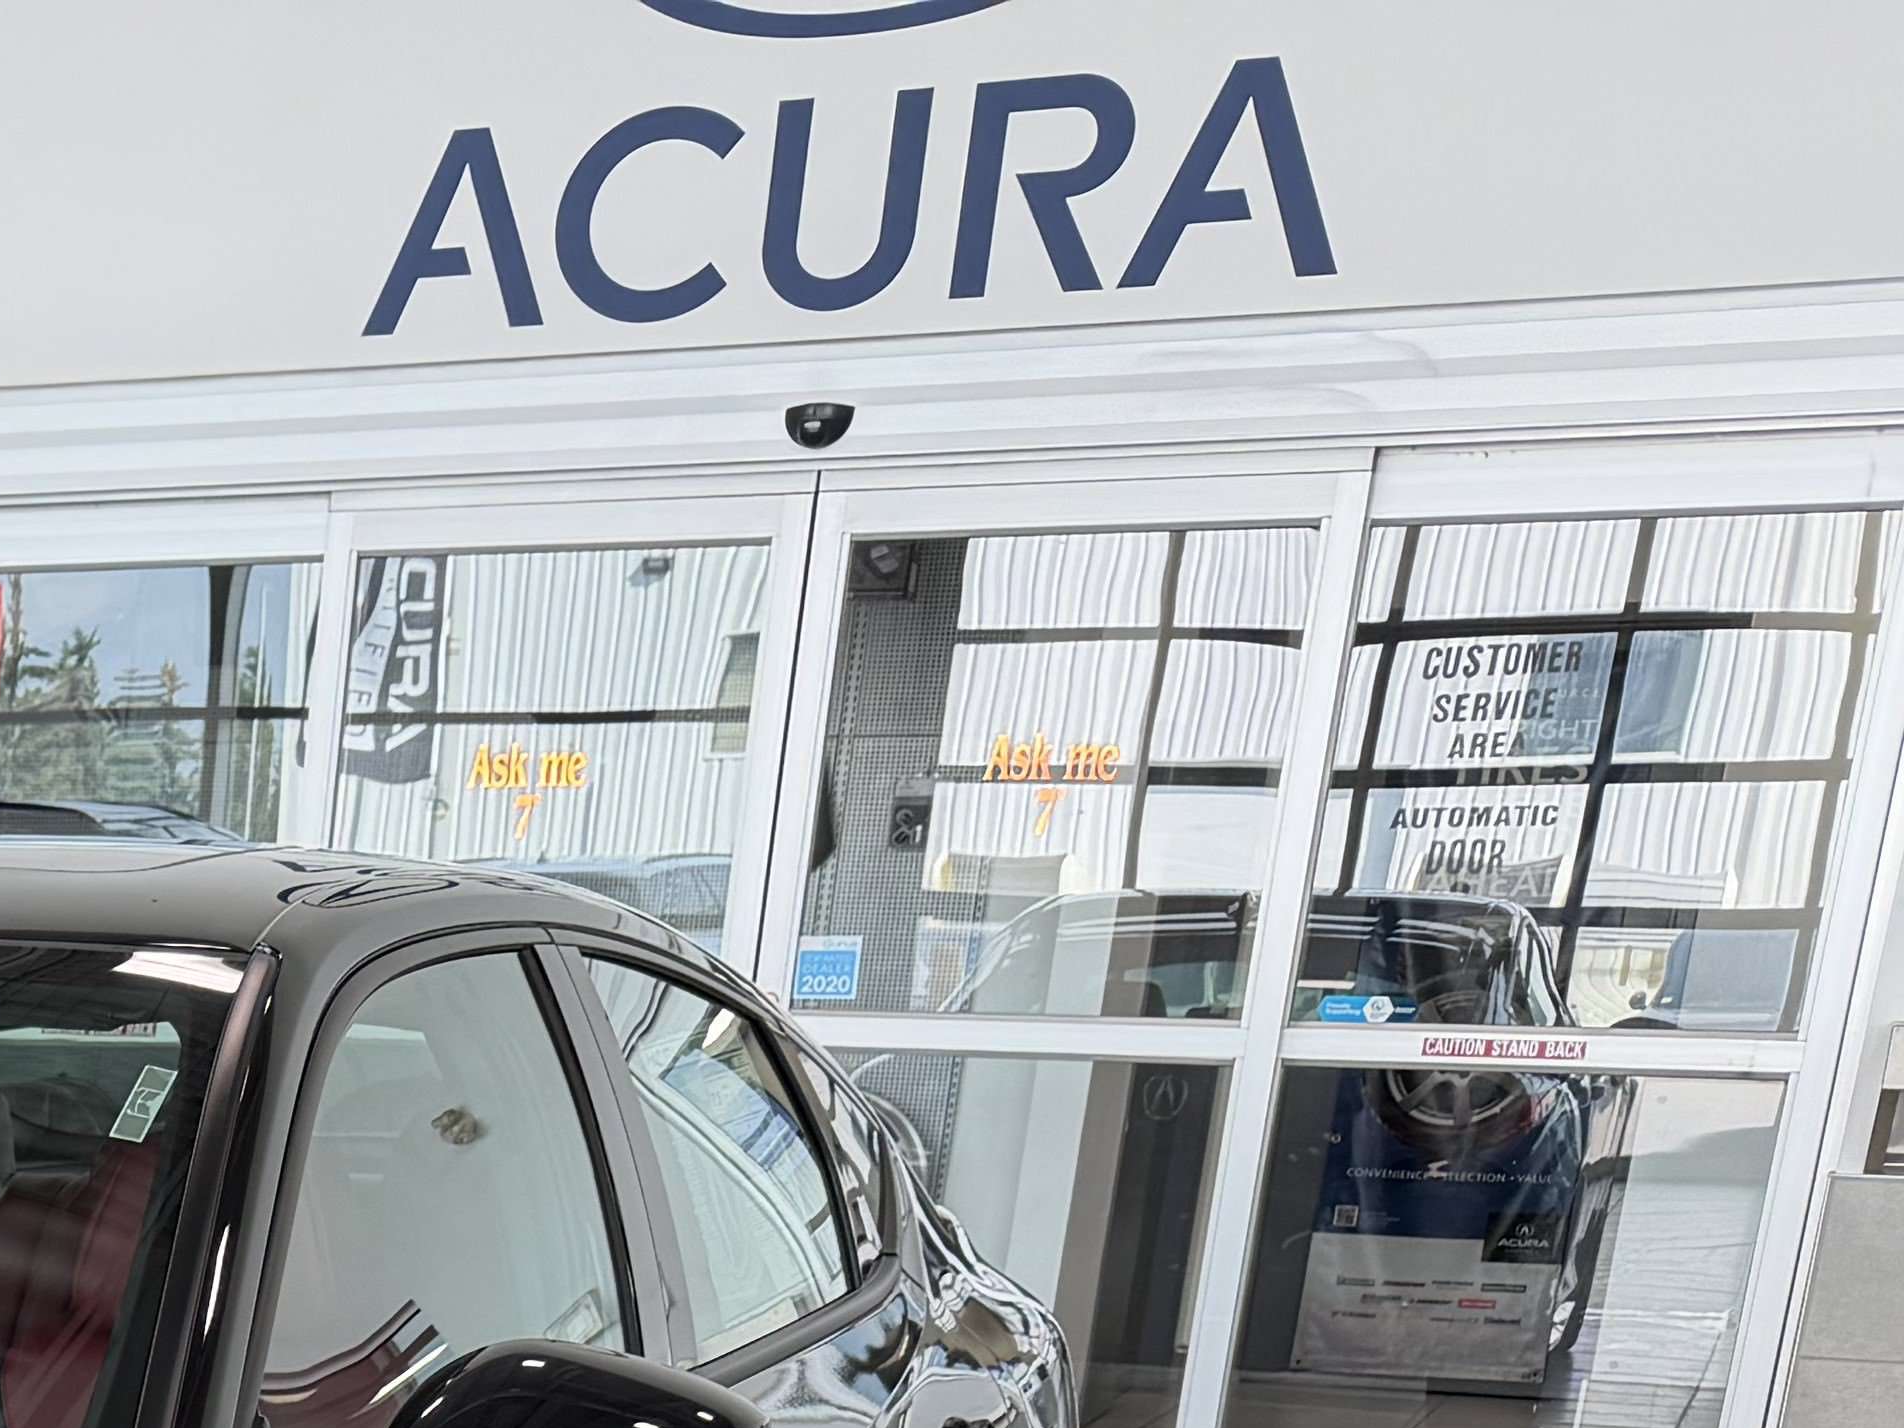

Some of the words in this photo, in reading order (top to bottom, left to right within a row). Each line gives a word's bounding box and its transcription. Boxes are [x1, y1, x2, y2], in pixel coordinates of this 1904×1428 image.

[362, 56, 1340, 336] ACURA
[385, 557, 436, 752] CURA
[1422, 641, 1583, 680] CUSTOMER
[1432, 688, 1557, 722] SERVICE
[982, 733, 1053, 782] Ask
[1062, 743, 1120, 783] me
[1448, 731, 1526, 759] AREA
[466, 742, 528, 790] Ask
[536, 751, 590, 790] me
[1390, 805, 1559, 830] AUTOMATIC
[1425, 839, 1506, 876] DOOR
[800, 975, 851, 993] 2020
[801, 962, 852, 974] DEALER
[1425, 1038, 1486, 1056] CAUTION
[1492, 1040, 1538, 1058] STAND
[1545, 1041, 1583, 1059] BACK
[1497, 1238, 1550, 1248] ACURA
